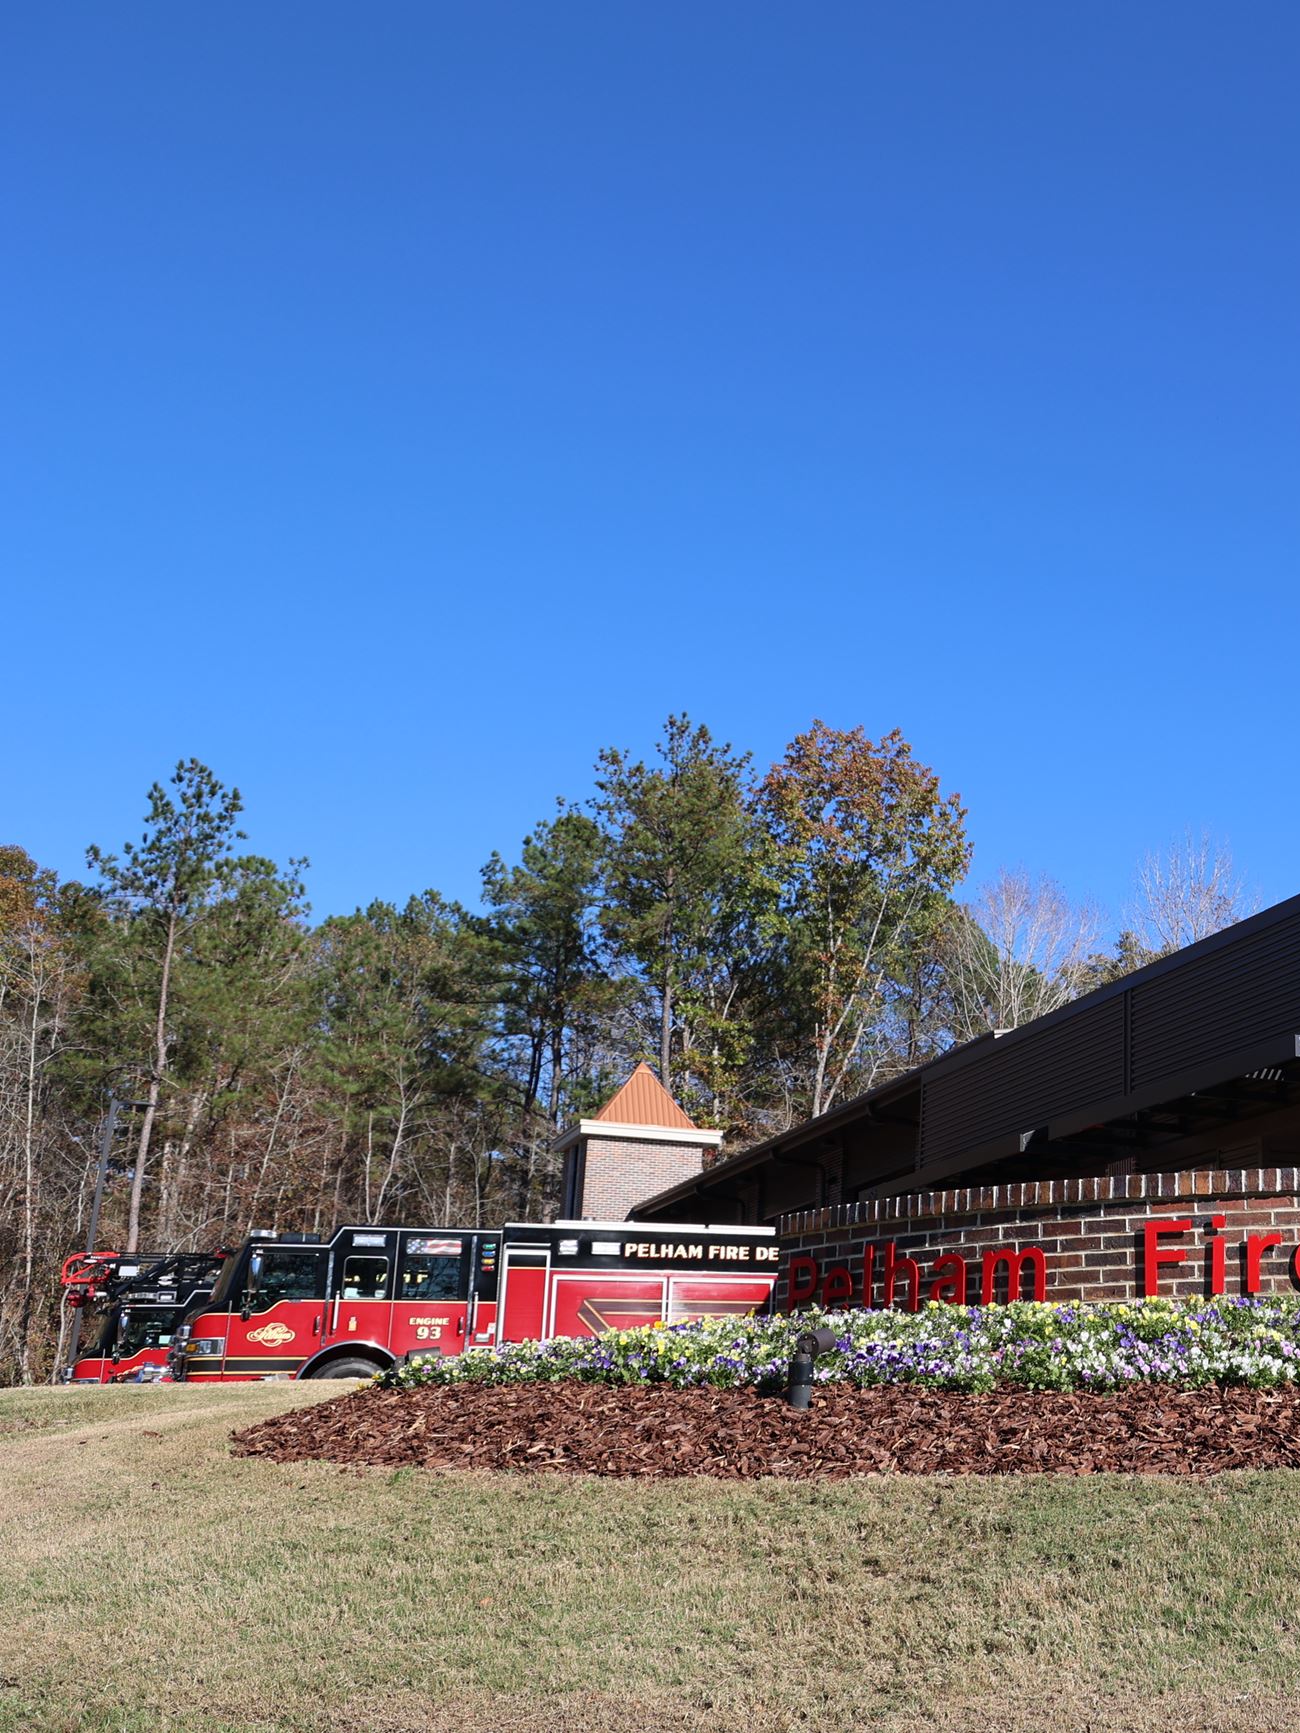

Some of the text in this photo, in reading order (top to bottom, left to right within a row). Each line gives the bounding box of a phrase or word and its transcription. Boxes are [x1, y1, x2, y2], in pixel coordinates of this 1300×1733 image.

[624, 1242, 780, 1261] PELHAM FIRE DE
[787, 1242, 1046, 1315] Pelham
[409, 1317, 449, 1326] ENGINE
[416, 1326, 441, 1340] 93
